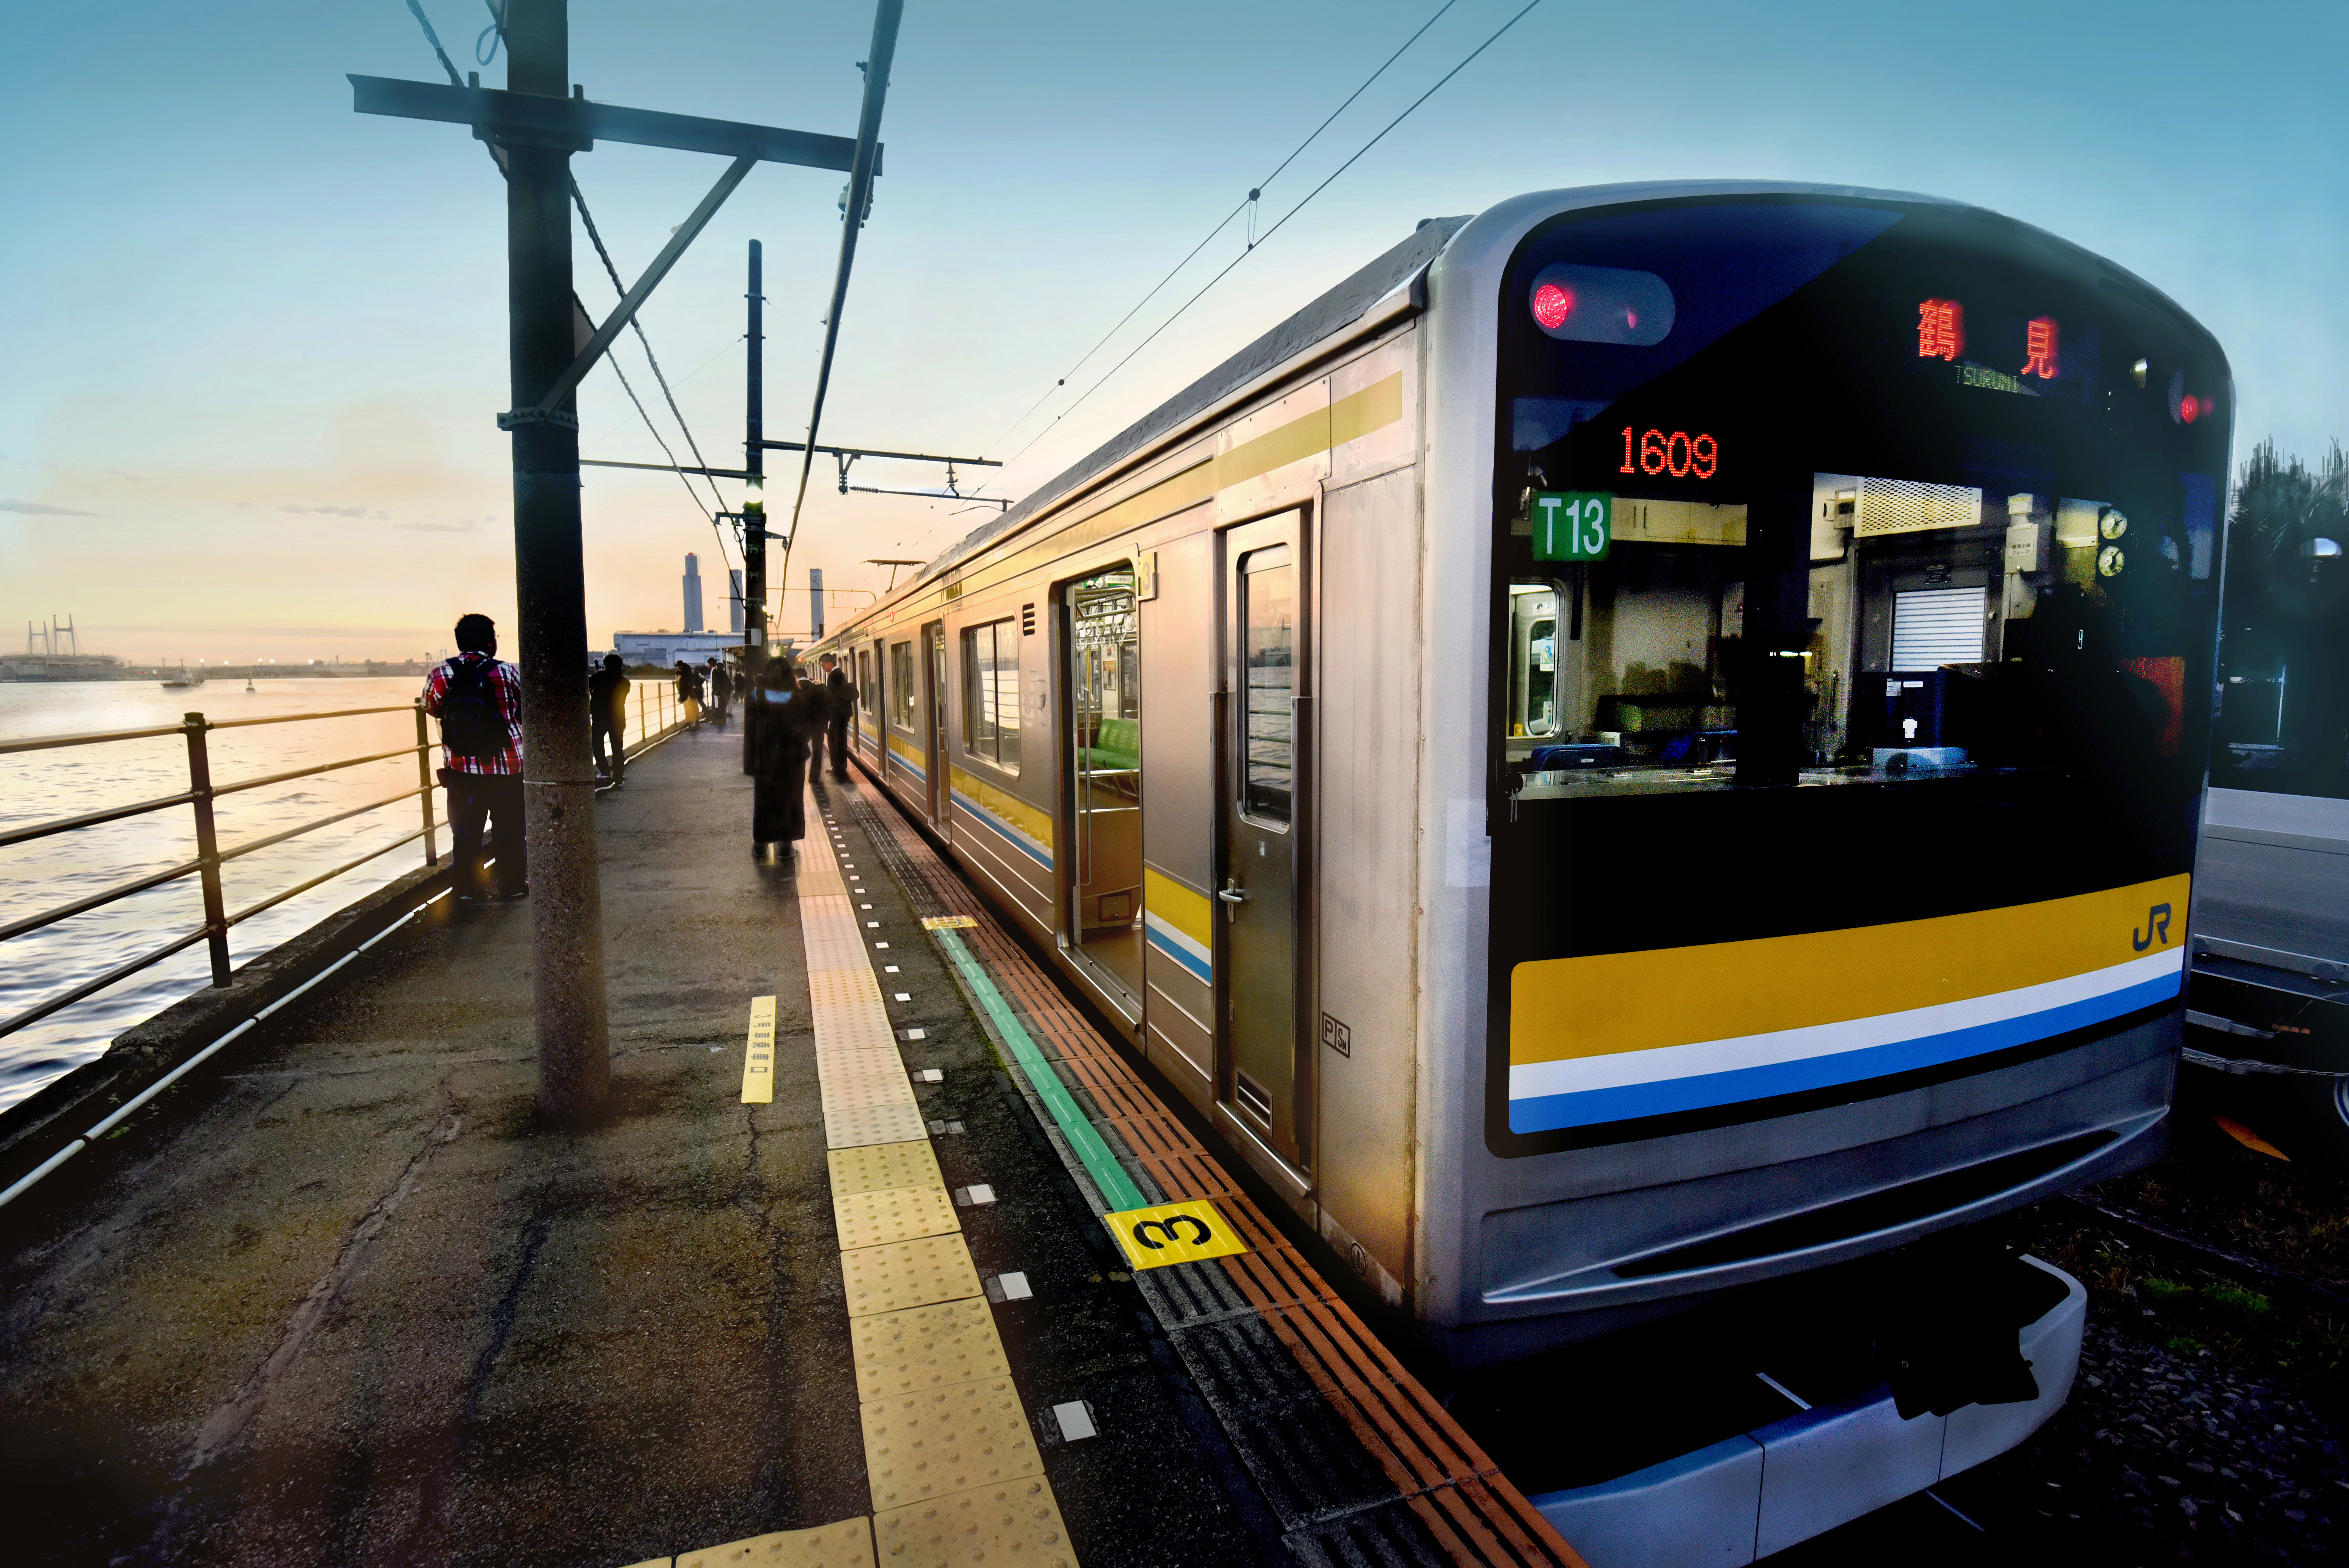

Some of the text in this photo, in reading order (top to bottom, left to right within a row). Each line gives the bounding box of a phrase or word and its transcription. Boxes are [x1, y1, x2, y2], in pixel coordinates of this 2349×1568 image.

[1620, 426, 1717, 479] 1609
[1539, 498, 1605, 555] T13
[1142, 561, 1151, 590] 3
[2132, 902, 2171, 951] JR
[749, 1014, 772, 1073] 3号車乗車口
[1133, 1214, 1212, 1249] 3
